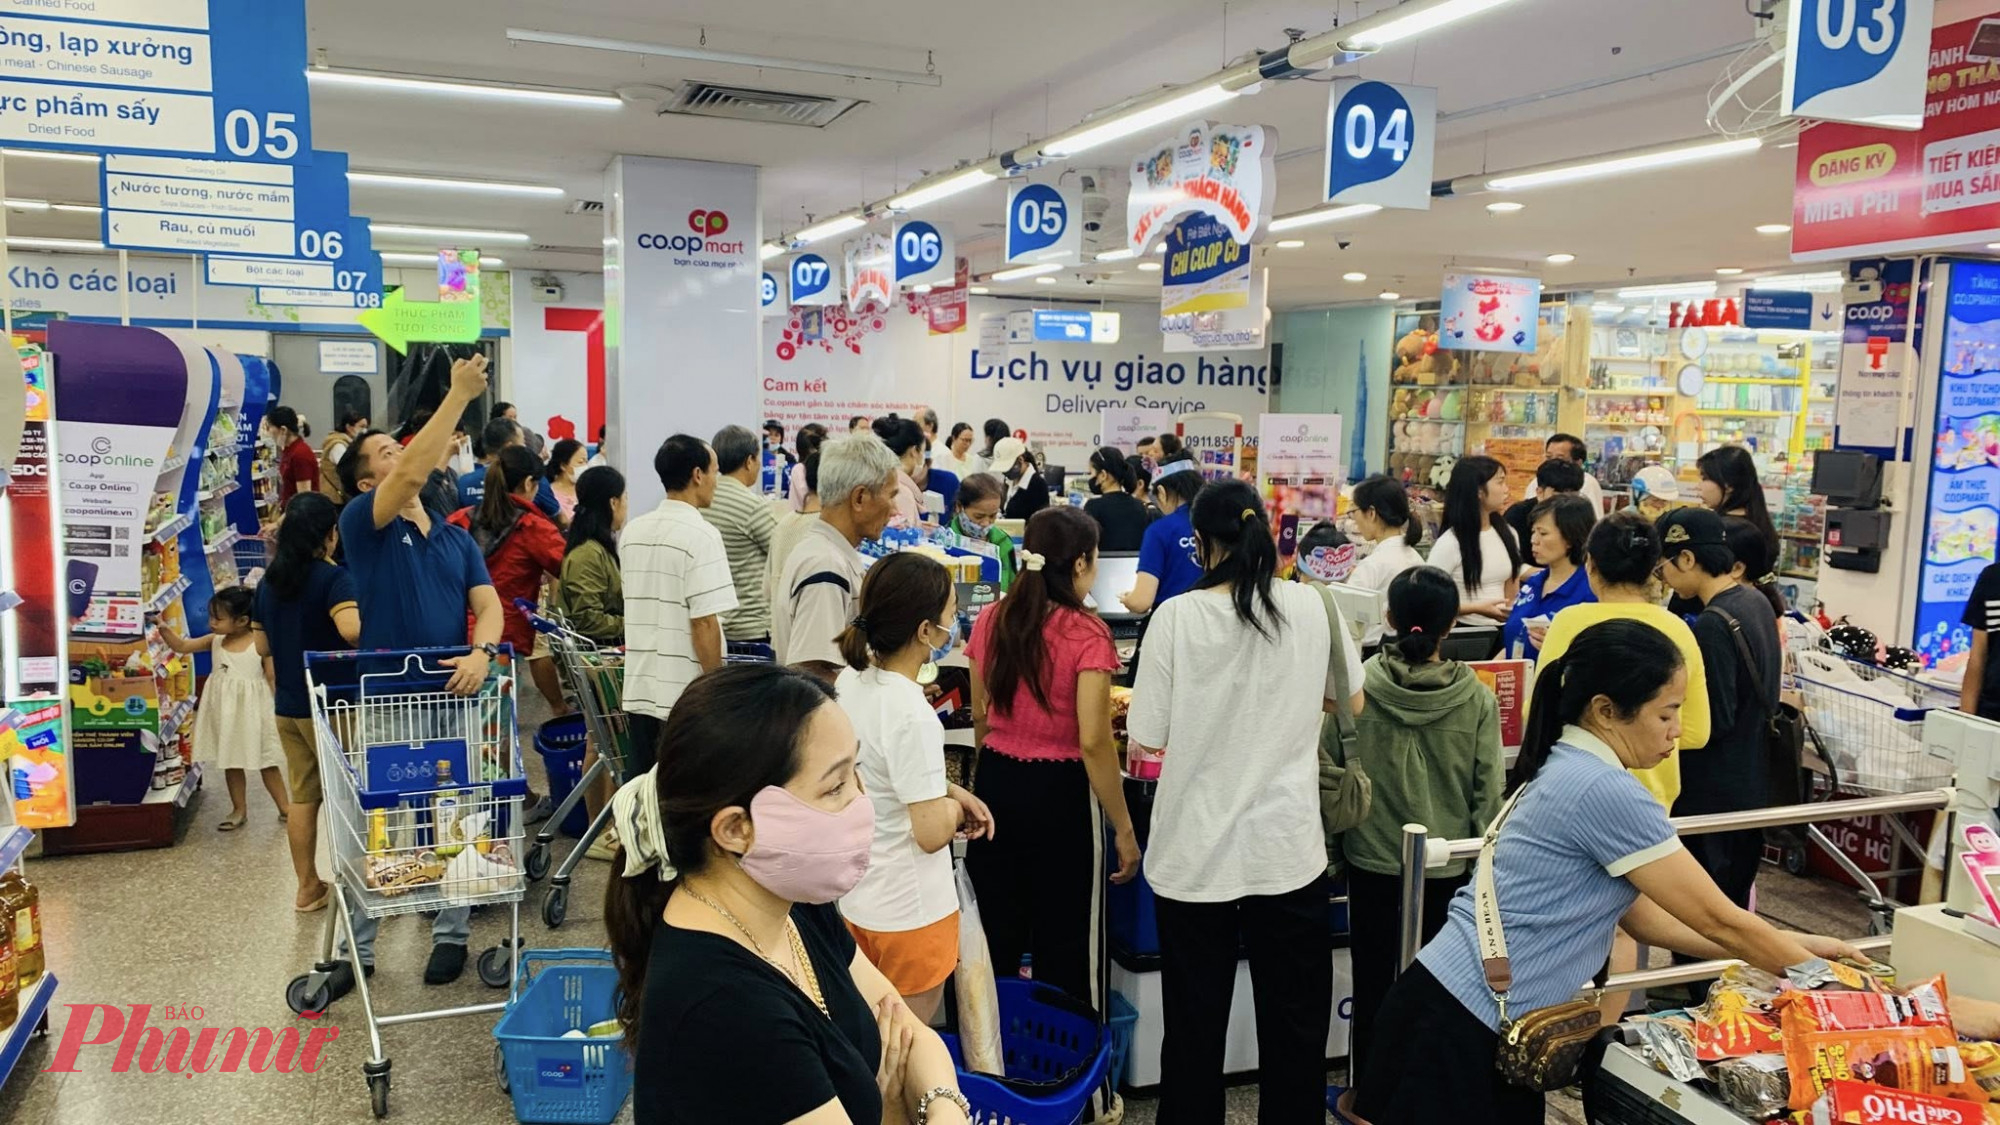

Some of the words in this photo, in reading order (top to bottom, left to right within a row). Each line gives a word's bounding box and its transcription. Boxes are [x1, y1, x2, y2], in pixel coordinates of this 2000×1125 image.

[65, 0, 95, 11] Food
[1817, 0, 1895, 55] 03
[60, 31, 98, 57] lạp
[107, 37, 192, 65] xưởng
[5, 58, 35, 68] meat
[47, 60, 97, 73] Chinese
[100, 64, 153, 79] Sausage
[36, 93, 108, 117] phẩm
[117, 98, 160, 125] sấy
[28, 123, 61, 135] Dried
[64, 125, 95, 137] Food
[224, 109, 298, 159] 05
[1344, 104, 1409, 162] 04
[1929, 147, 1962, 175] TIẾT
[121, 181, 162, 194] Nước
[165, 184, 214, 200] tương,
[217, 188, 254, 201] nước
[258, 189, 290, 204] mắm
[1926, 180, 1964, 201] MUA
[160, 220, 194, 234] Rau,
[219, 223, 256, 237] muối
[1018, 200, 1062, 235] 05
[299, 230, 344, 258] 06
[637, 233, 703, 255] co.op
[705, 240, 744, 254] mart
[900, 231, 940, 262] 06
[69, 268, 117, 292] các
[128, 271, 176, 300] loại
[335, 270, 367, 291] 07
[796, 262, 828, 287] 07
[356, 292, 381, 307] 08
[1846, 306, 1894, 323] co.op
[1062, 357, 1102, 390] vụ
[1114, 355, 1185, 391] giao
[763, 378, 799, 392] Cam
[804, 377, 827, 393] kết
[11, 464, 47, 476] SDC
[103, 455, 154, 468] online
[69, 481, 97, 491] Co.op
[99, 483, 131, 492] Online
[64, 507, 132, 517] cooponline.vn
